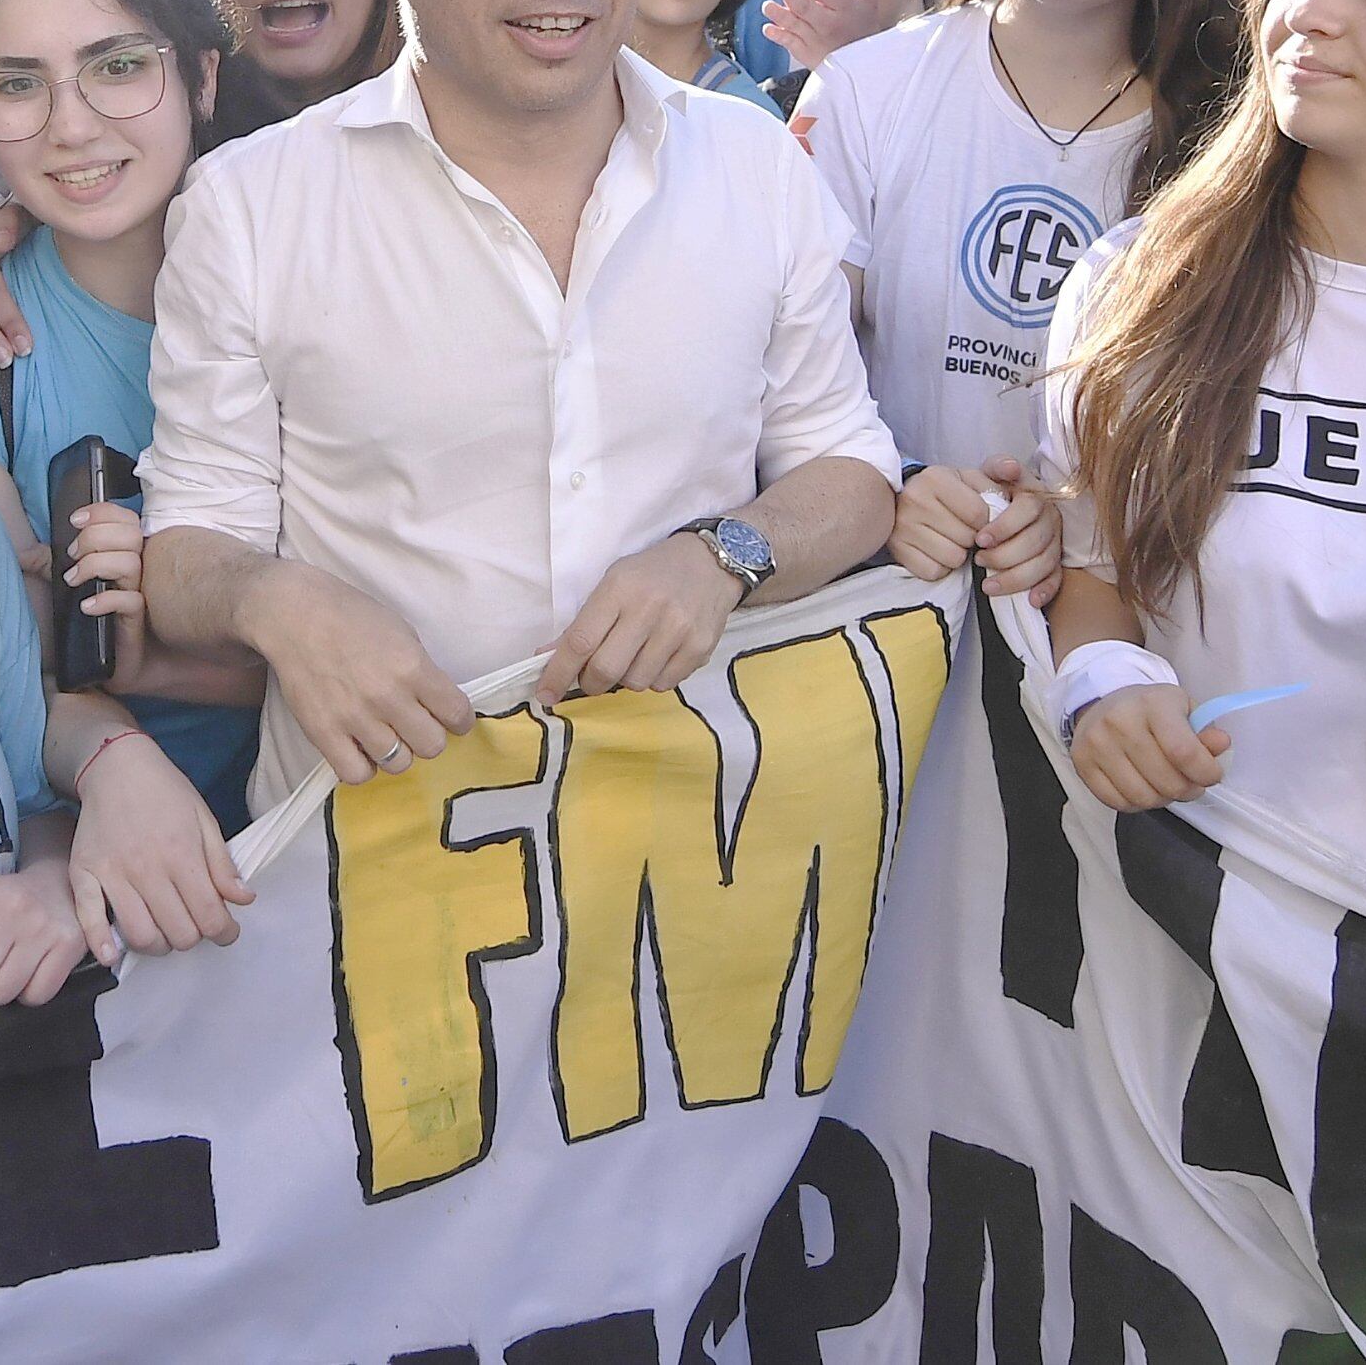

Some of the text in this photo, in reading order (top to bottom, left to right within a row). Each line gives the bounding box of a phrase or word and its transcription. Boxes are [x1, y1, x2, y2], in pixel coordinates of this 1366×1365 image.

[988, 209, 1080, 302] FES
[948, 335, 1036, 368] PROVINCI
[945, 356, 1022, 386] BUENOS
